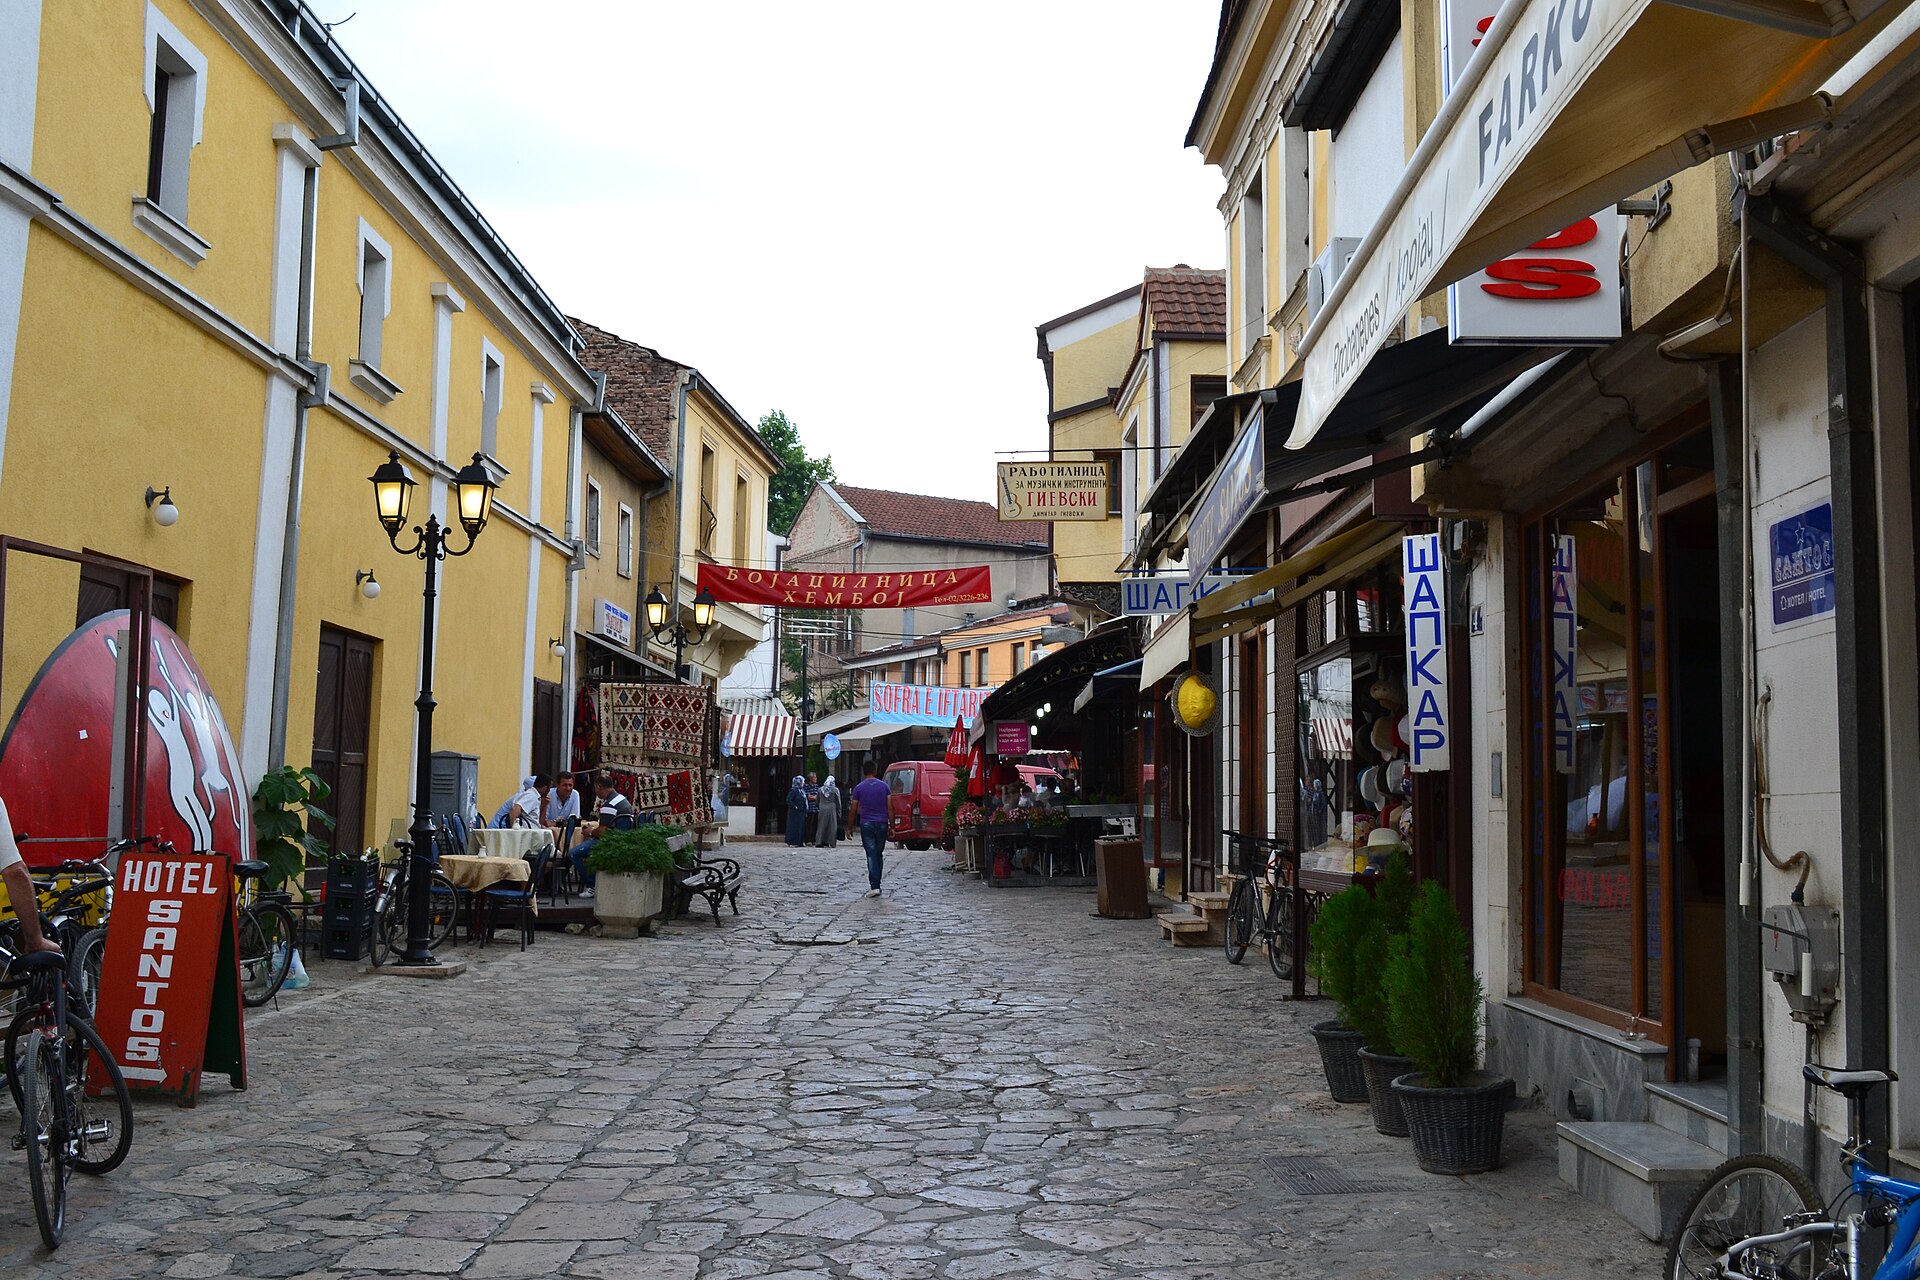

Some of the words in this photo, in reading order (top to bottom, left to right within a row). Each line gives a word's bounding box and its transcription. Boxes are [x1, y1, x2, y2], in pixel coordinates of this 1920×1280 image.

[1009, 466, 1106, 478] РАБОТИЛНИЦА
[1015, 480, 1024, 489] ЗА
[1027, 480, 1062, 489] МУЗИЧКИ
[1064, 479, 1107, 489] ИНСТРУМЕНТИ
[1027, 491, 1097, 507] ГИЕВСКИ
[726, 567, 959, 590] БОЈАЏИЛНИЦА
[782, 589, 904, 607] ХЕМБОЈ
[1127, 580, 1269, 611] ШАПК
[1787, 592, 1805, 609] ХОТЕЛ
[1808, 587, 1827, 601] HOTEL
[1408, 536, 1446, 766] ШАПКАР
[873, 683, 920, 715] SOFRA
[924, 687, 933, 716] E
[937, 688, 992, 718] IFTARI
[123, 861, 219, 895] HOTEL
[1556, 867, 1595, 903] OPEN
[125, 899, 184, 1063] SANTOS
